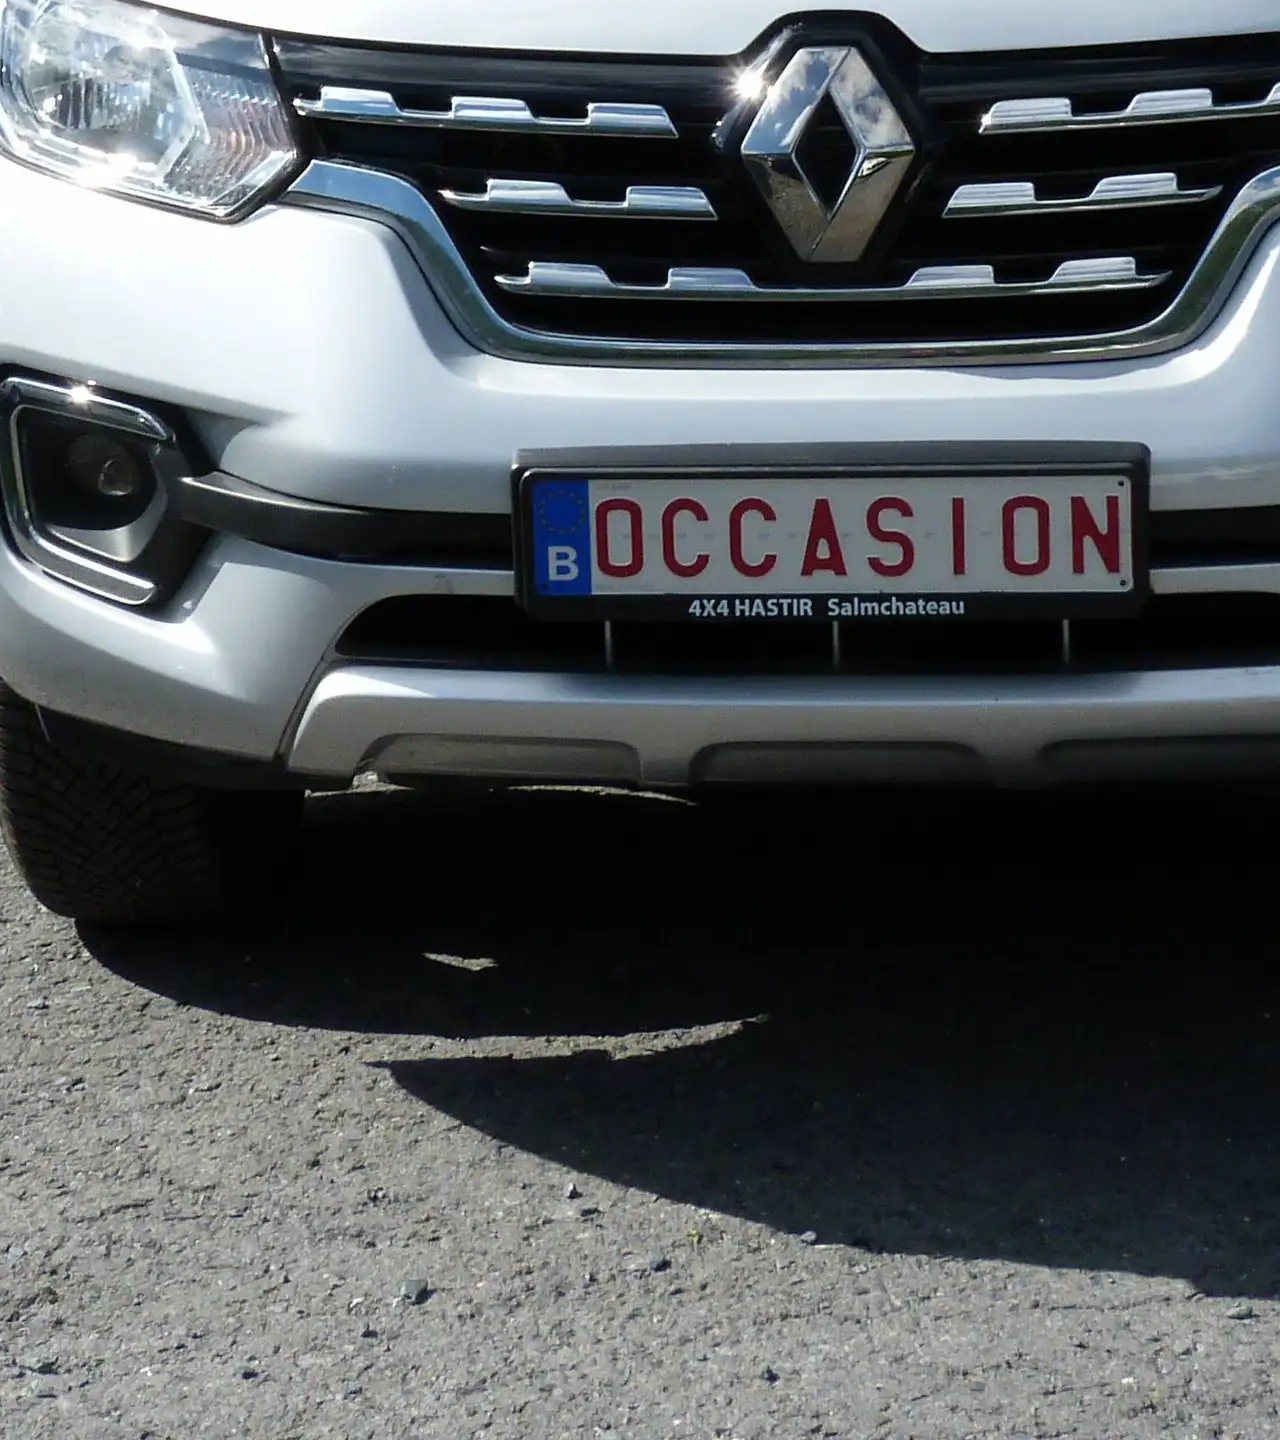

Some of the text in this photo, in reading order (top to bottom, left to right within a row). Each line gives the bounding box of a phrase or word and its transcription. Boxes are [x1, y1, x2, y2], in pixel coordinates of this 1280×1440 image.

[595, 495, 1120, 578] OCCASION
[547, 545, 579, 581] B
[688, 596, 966, 617] 4X4 HASTIR Salmchateau
